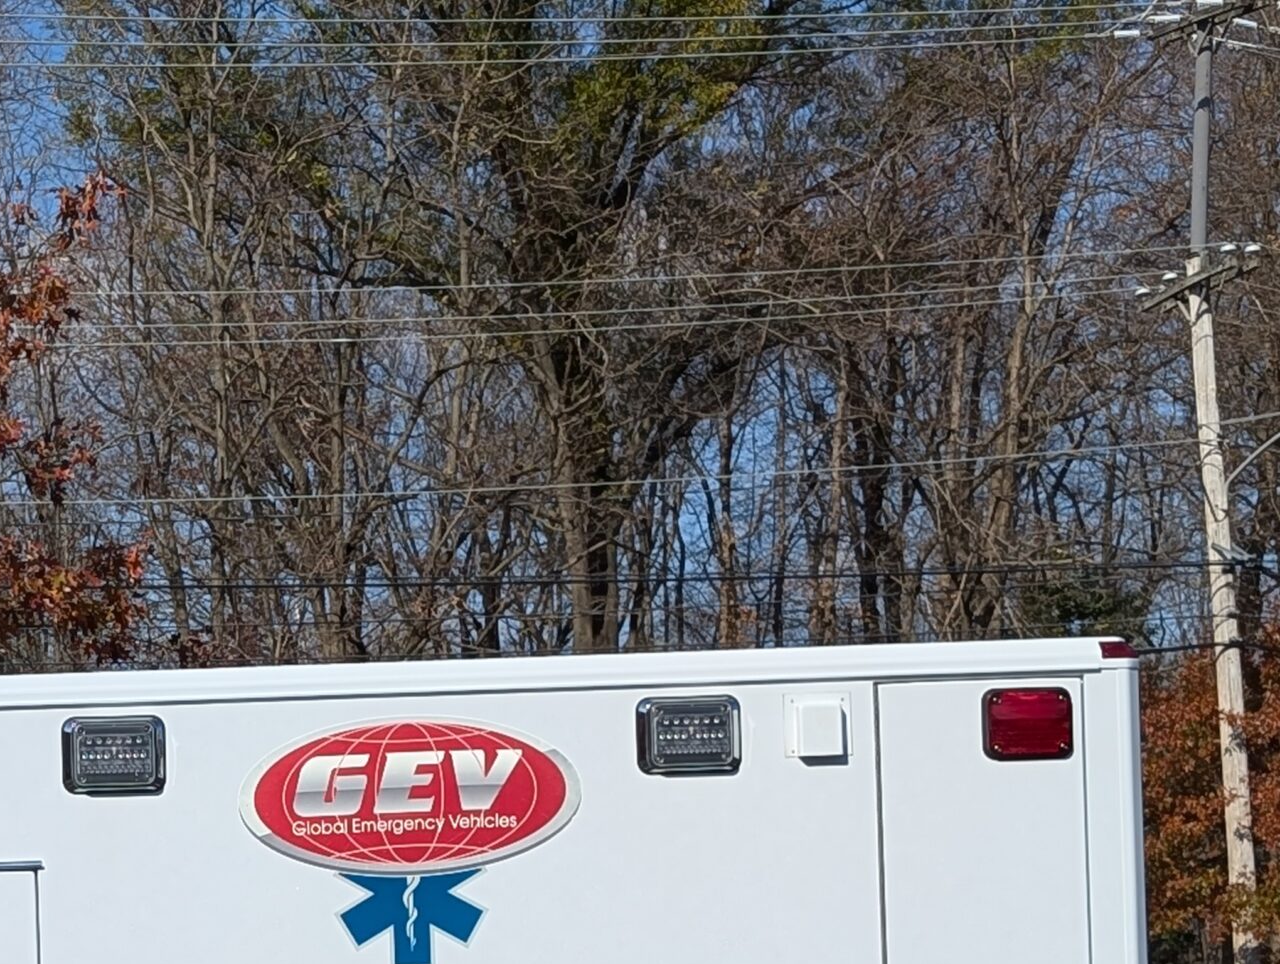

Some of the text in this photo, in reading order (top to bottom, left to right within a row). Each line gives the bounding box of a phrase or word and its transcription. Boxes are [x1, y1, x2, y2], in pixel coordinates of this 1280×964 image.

[292, 749, 523, 818] GEV
[292, 813, 518, 837] Global Emergency Vehicles
